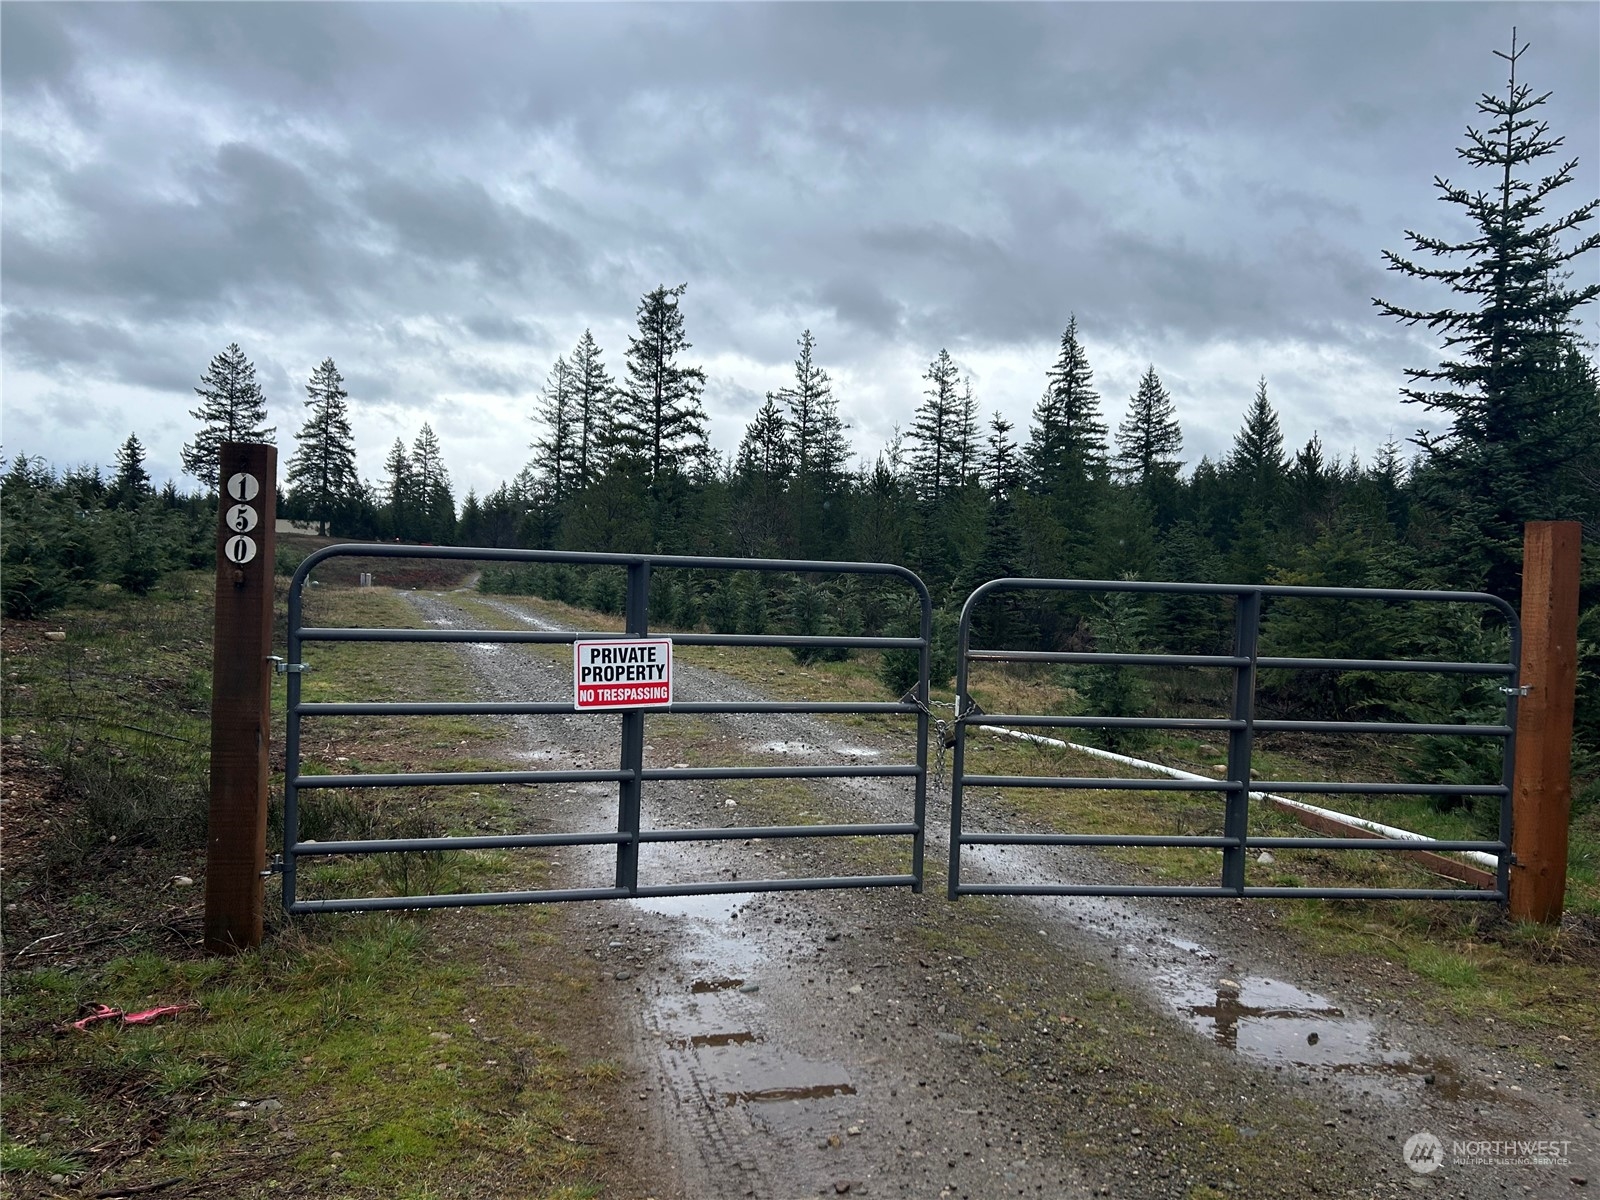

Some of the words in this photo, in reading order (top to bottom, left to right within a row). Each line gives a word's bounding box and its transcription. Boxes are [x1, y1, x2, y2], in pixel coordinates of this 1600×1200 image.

[233, 476, 250, 563] 150
[590, 647, 657, 664] PRIVATE
[581, 664, 666, 682] PROPERTY
[579, 689, 595, 702] NO
[597, 686, 668, 702] TRESPASSING
